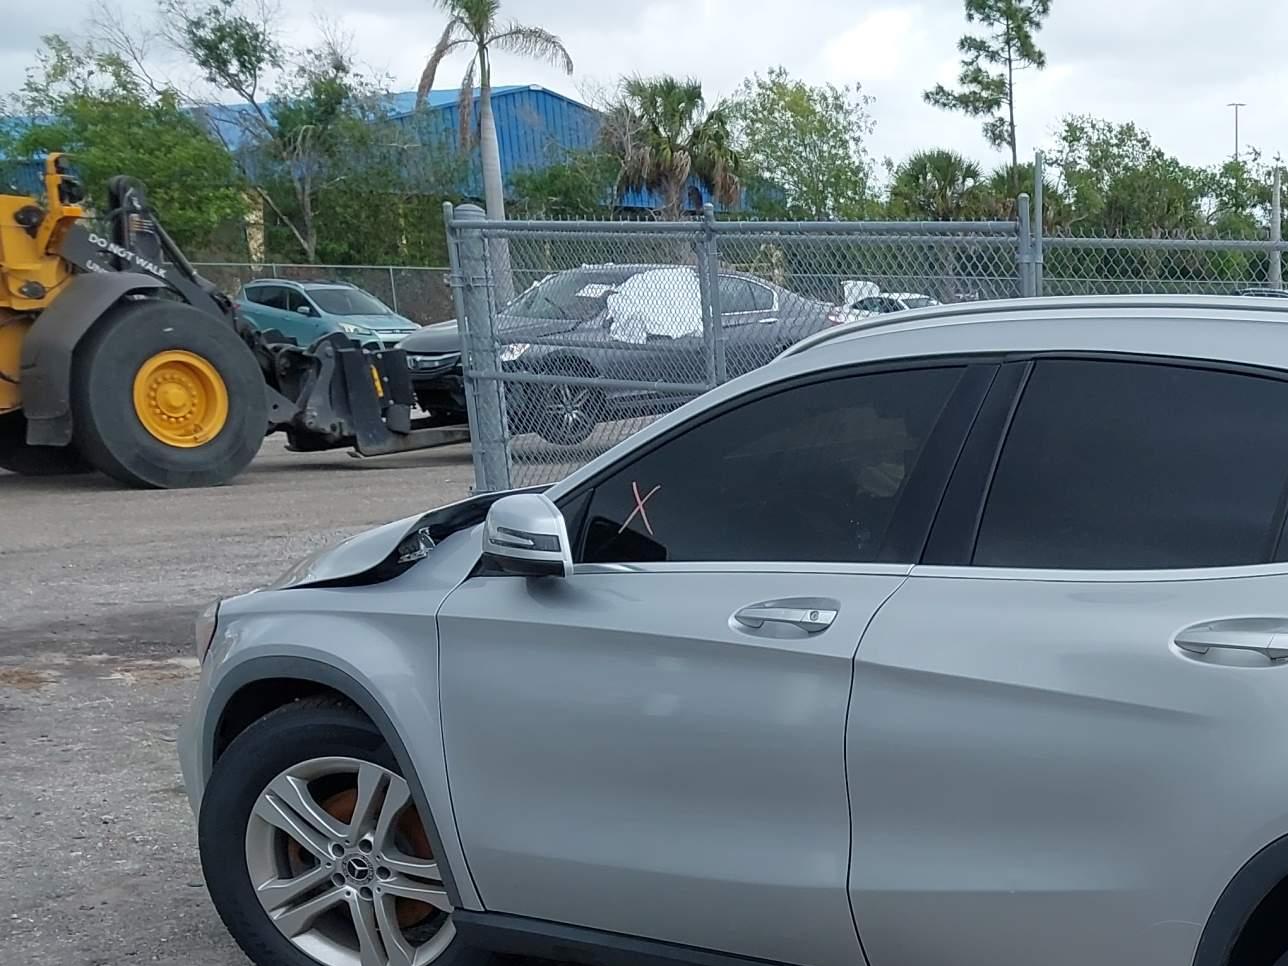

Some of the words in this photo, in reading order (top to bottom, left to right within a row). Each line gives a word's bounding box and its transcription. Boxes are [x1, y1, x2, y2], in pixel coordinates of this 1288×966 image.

[88, 233, 108, 248] DO
[107, 242, 135, 261] NOT
[135, 256, 168, 278] WALK
